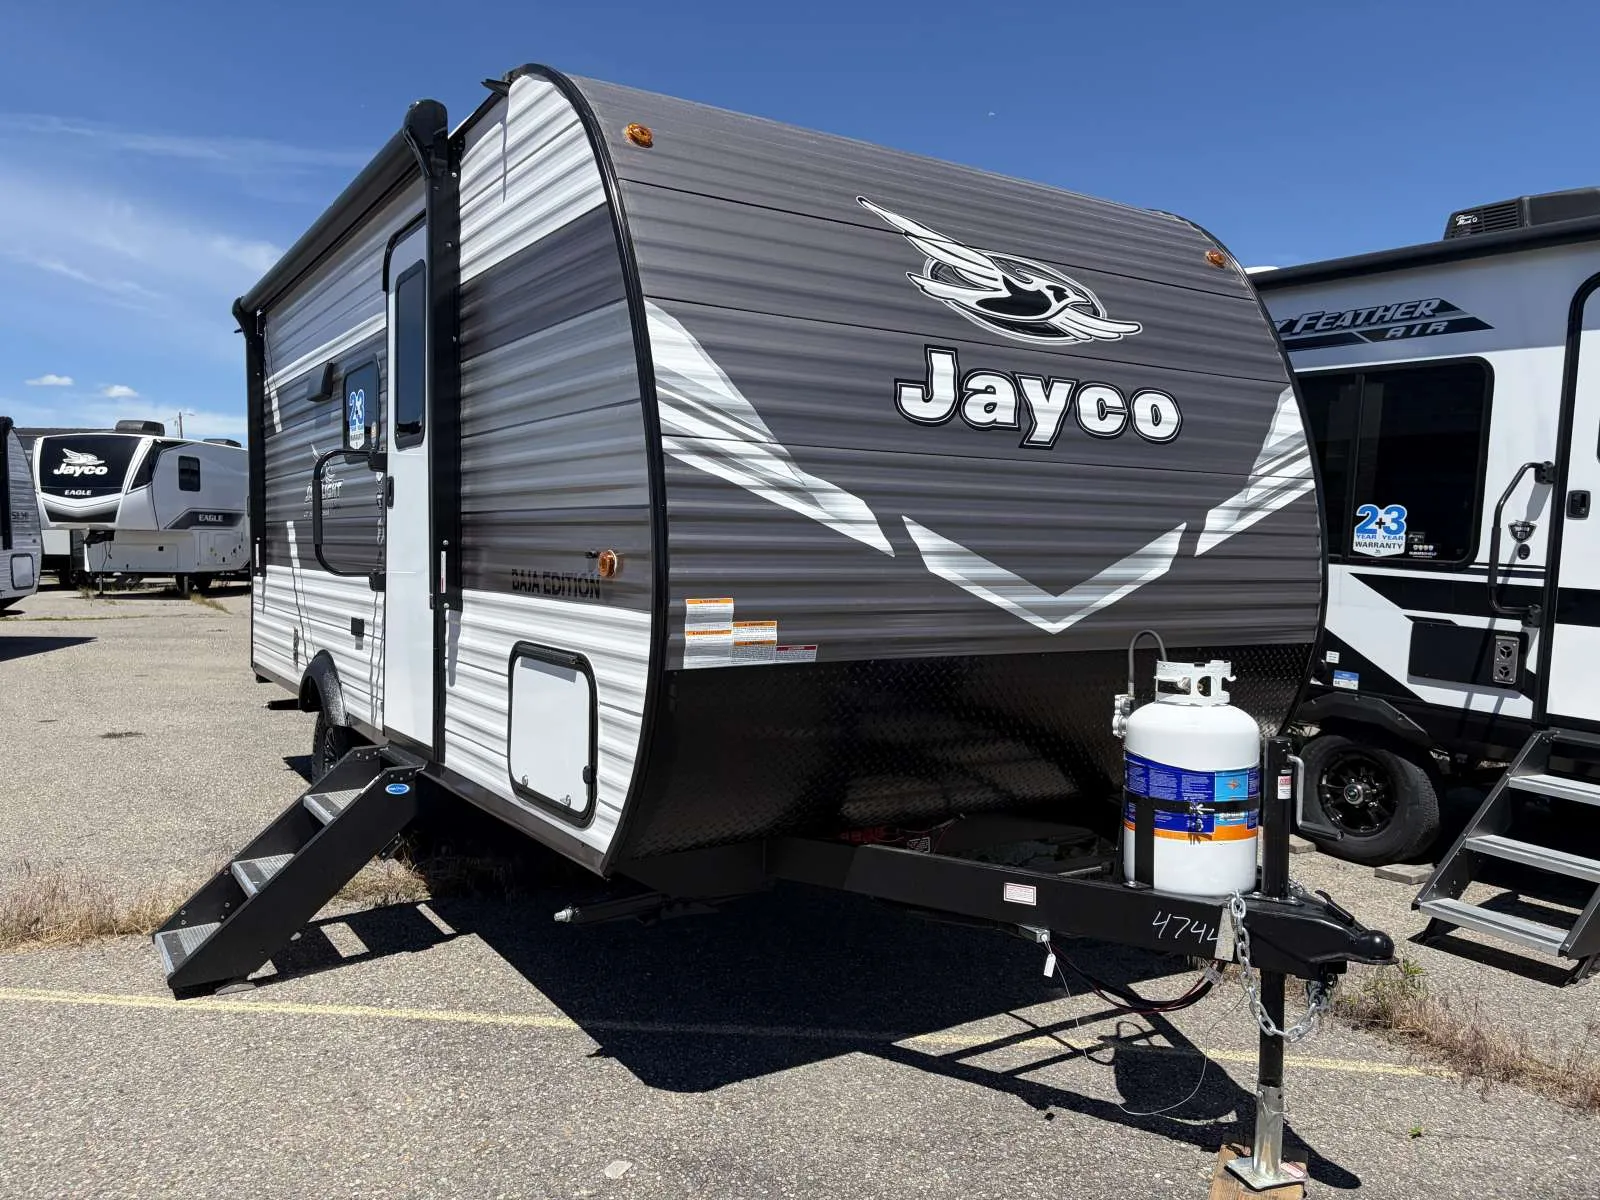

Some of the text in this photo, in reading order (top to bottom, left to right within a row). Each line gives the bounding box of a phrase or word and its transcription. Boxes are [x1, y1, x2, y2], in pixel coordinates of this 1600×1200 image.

[1291, 299, 1441, 335] FEATHER
[1384, 321, 1449, 339] AIR
[895, 345, 1182, 448] Jayco
[53, 463, 108, 477] Jayco
[198, 513, 224, 522] EAGLE
[1355, 541, 1403, 549] WARRANTY
[512, 568, 601, 600] BAJA EDITION
